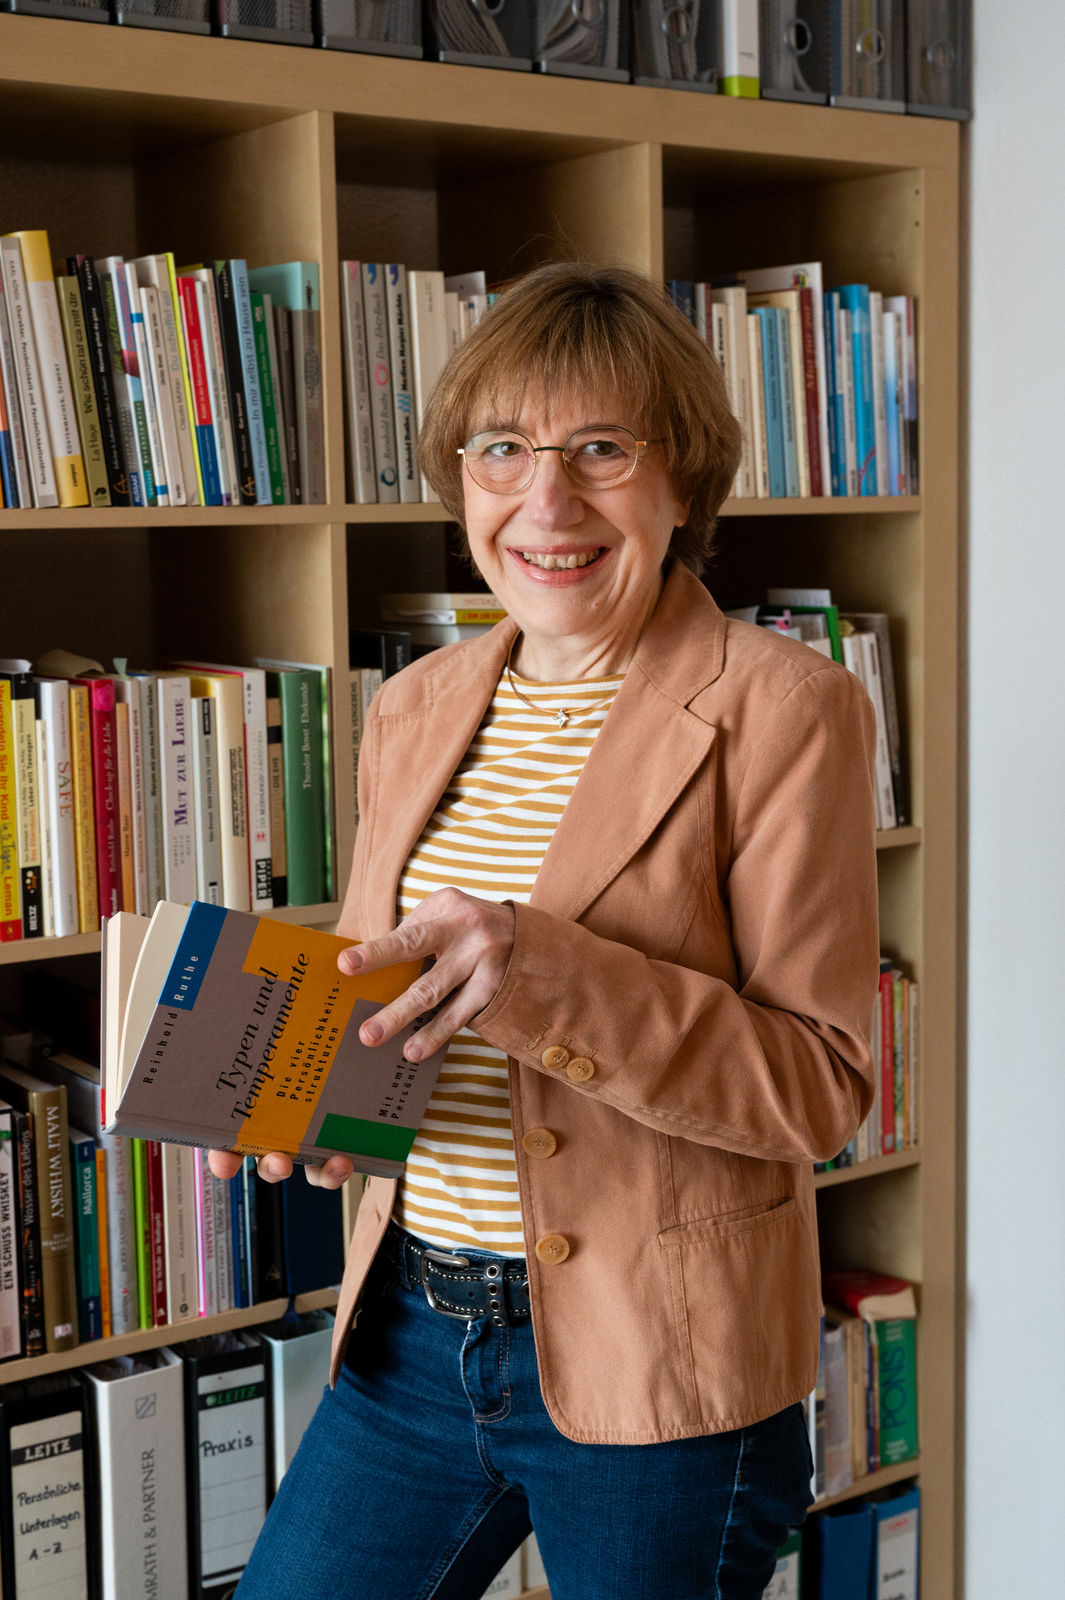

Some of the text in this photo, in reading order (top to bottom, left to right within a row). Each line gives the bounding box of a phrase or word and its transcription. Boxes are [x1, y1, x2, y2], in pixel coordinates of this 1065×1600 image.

[68, 290, 95, 415] Wie schön ist es mit dir
[238, 275, 261, 421] In mir selbst zu Hause sein
[397, 326, 408, 358] Magier
[169, 354, 180, 372] Du
[399, 358, 408, 391] Medien
[402, 415, 414, 481] Reinhold Ruthe
[145, 684, 153, 706] lieben
[350, 681, 359, 727] VERGEBENS
[101, 720, 112, 744] Liebe
[147, 729, 155, 747] noch
[171, 697, 187, 747] LIEBE
[300, 681, 312, 790] Theodor Bovet Ehekunde
[0, 754, 8, 773] Sie
[102, 743, 112, 758] die
[102, 758, 113, 770] für
[0, 775, 9, 791] Ihr
[149, 772, 158, 797] Warum
[176, 754, 188, 783] ZUR
[27, 785, 35, 807] Leben
[56, 761, 72, 818] SAFE
[1, 793, 10, 821] Kind
[3, 875, 13, 917] Leman
[257, 861, 268, 898] PIPER
[28, 904, 38, 932] BELTZ
[142, 955, 199, 1084] Reinhold Ruthe
[216, 966, 279, 1091] Typen und
[231, 953, 310, 1120] Temperamente
[290, 982, 340, 1100] Persönlichkeits-
[276, 1041, 305, 1098] Die vier
[305, 1027, 339, 1103] strukturen
[378, 1096, 394, 1117] Mit
[46, 1106, 61, 1150] MALT
[20, 1129, 35, 1226] Wasser des Lebens
[48, 1153, 64, 1218] WHISKY
[82, 1166, 93, 1215] Mallorca
[203, 1167, 212, 1188] SEI
[203, 1188, 213, 1218] KEIN
[0, 1171, 14, 1290] EIN SCHUSS WHISKEY
[205, 1218, 215, 1260] MANN
[217, 1385, 257, 1405] LEITZ
[881, 1346, 906, 1431] PONS
[24, 1438, 71, 1461] LEITZ
[199, 1430, 254, 1457] Praxis
[17, 1481, 82, 1507] Persönliche
[141, 1448, 157, 1524] PARTNER
[19, 1511, 81, 1535] Unterlagen
[143, 1526, 157, 1540] &
